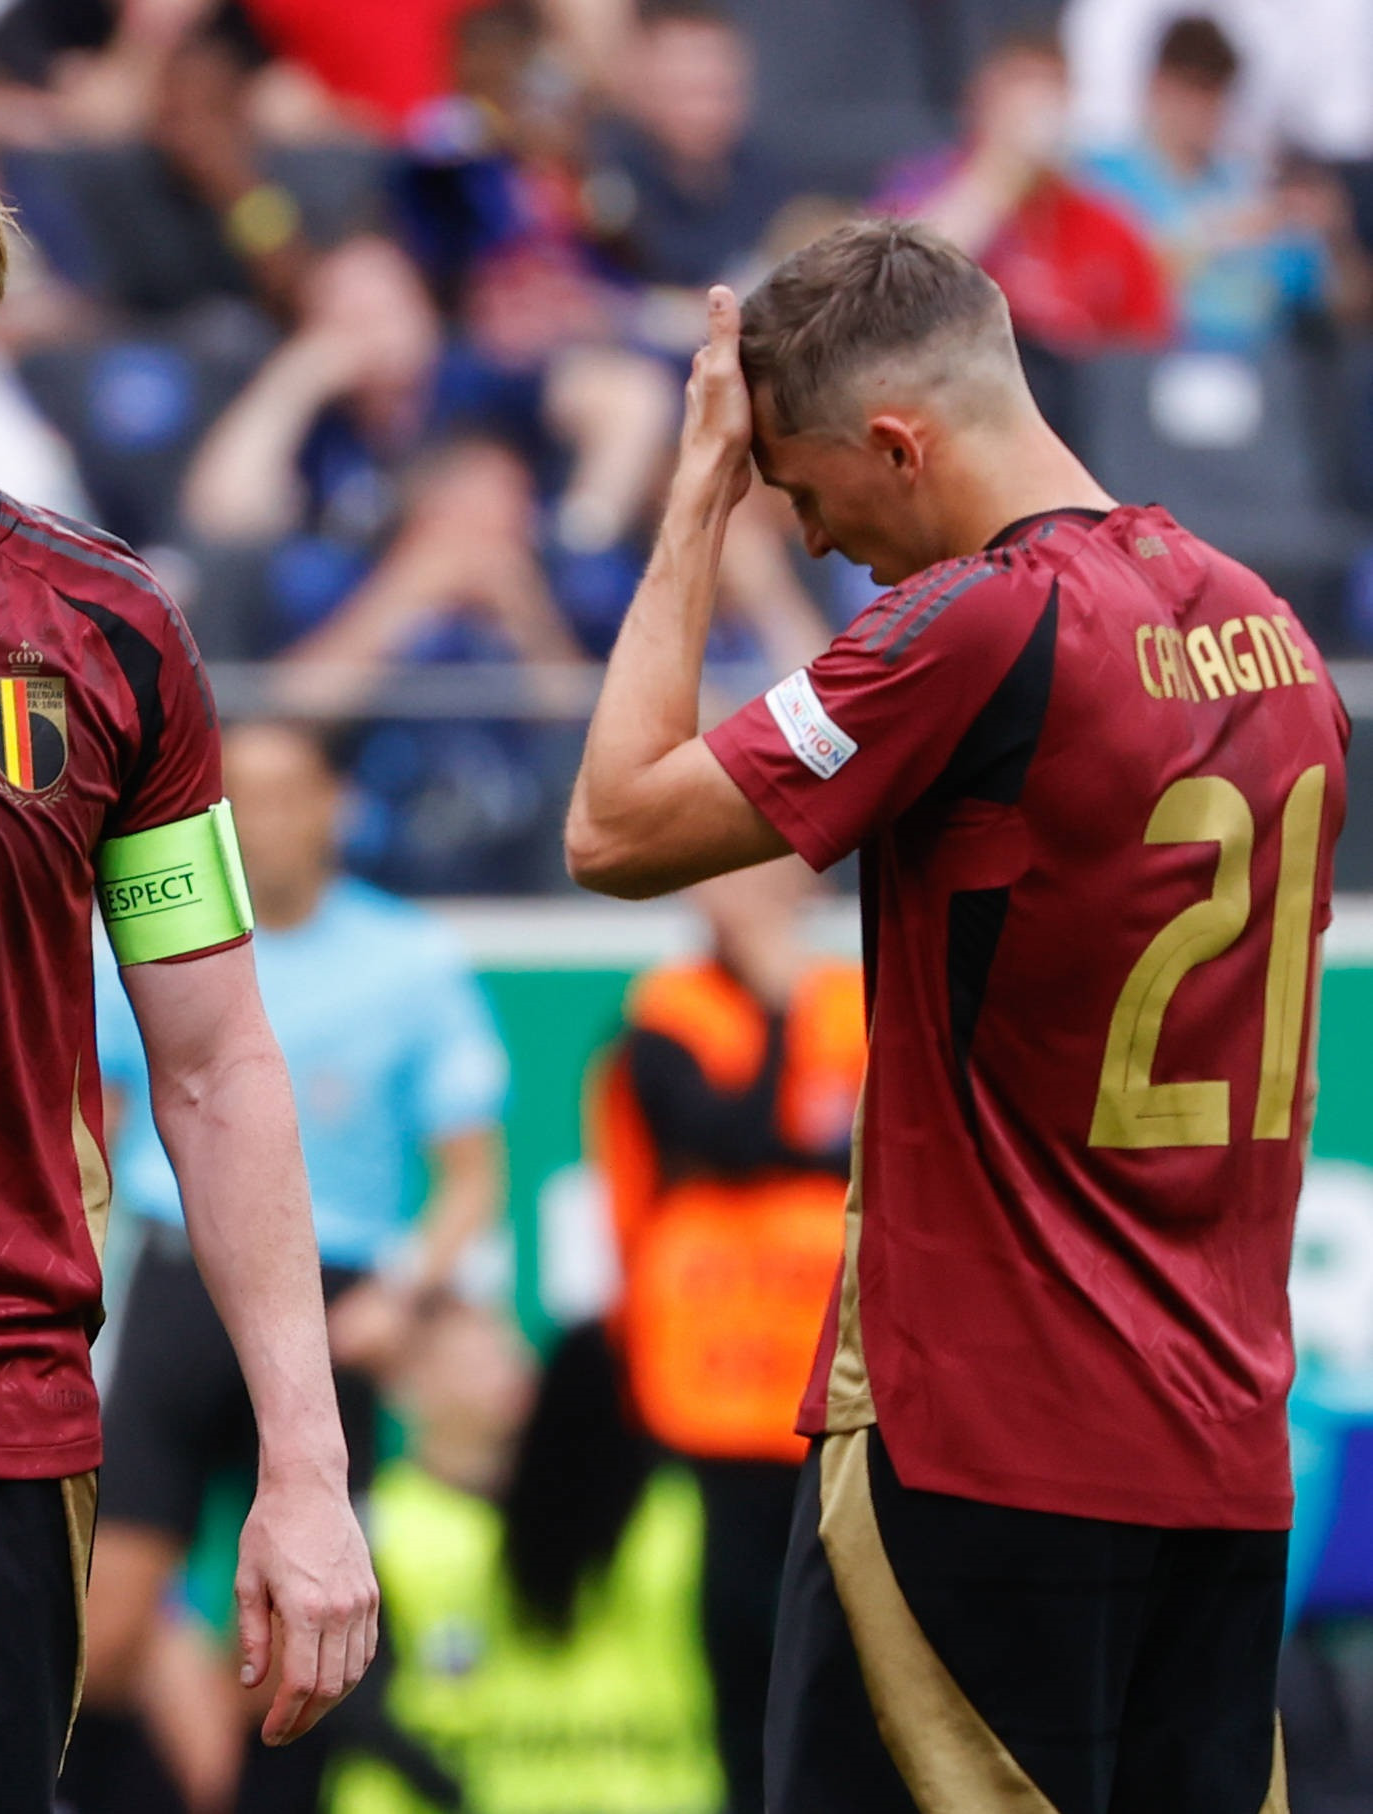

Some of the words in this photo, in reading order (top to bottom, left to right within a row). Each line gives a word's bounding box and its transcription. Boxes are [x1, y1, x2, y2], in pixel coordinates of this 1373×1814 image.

[1136, 614, 1318, 703] CAAGNE
[103, 872, 195, 914] ESPECT
[1088, 763, 1326, 1148] 21
